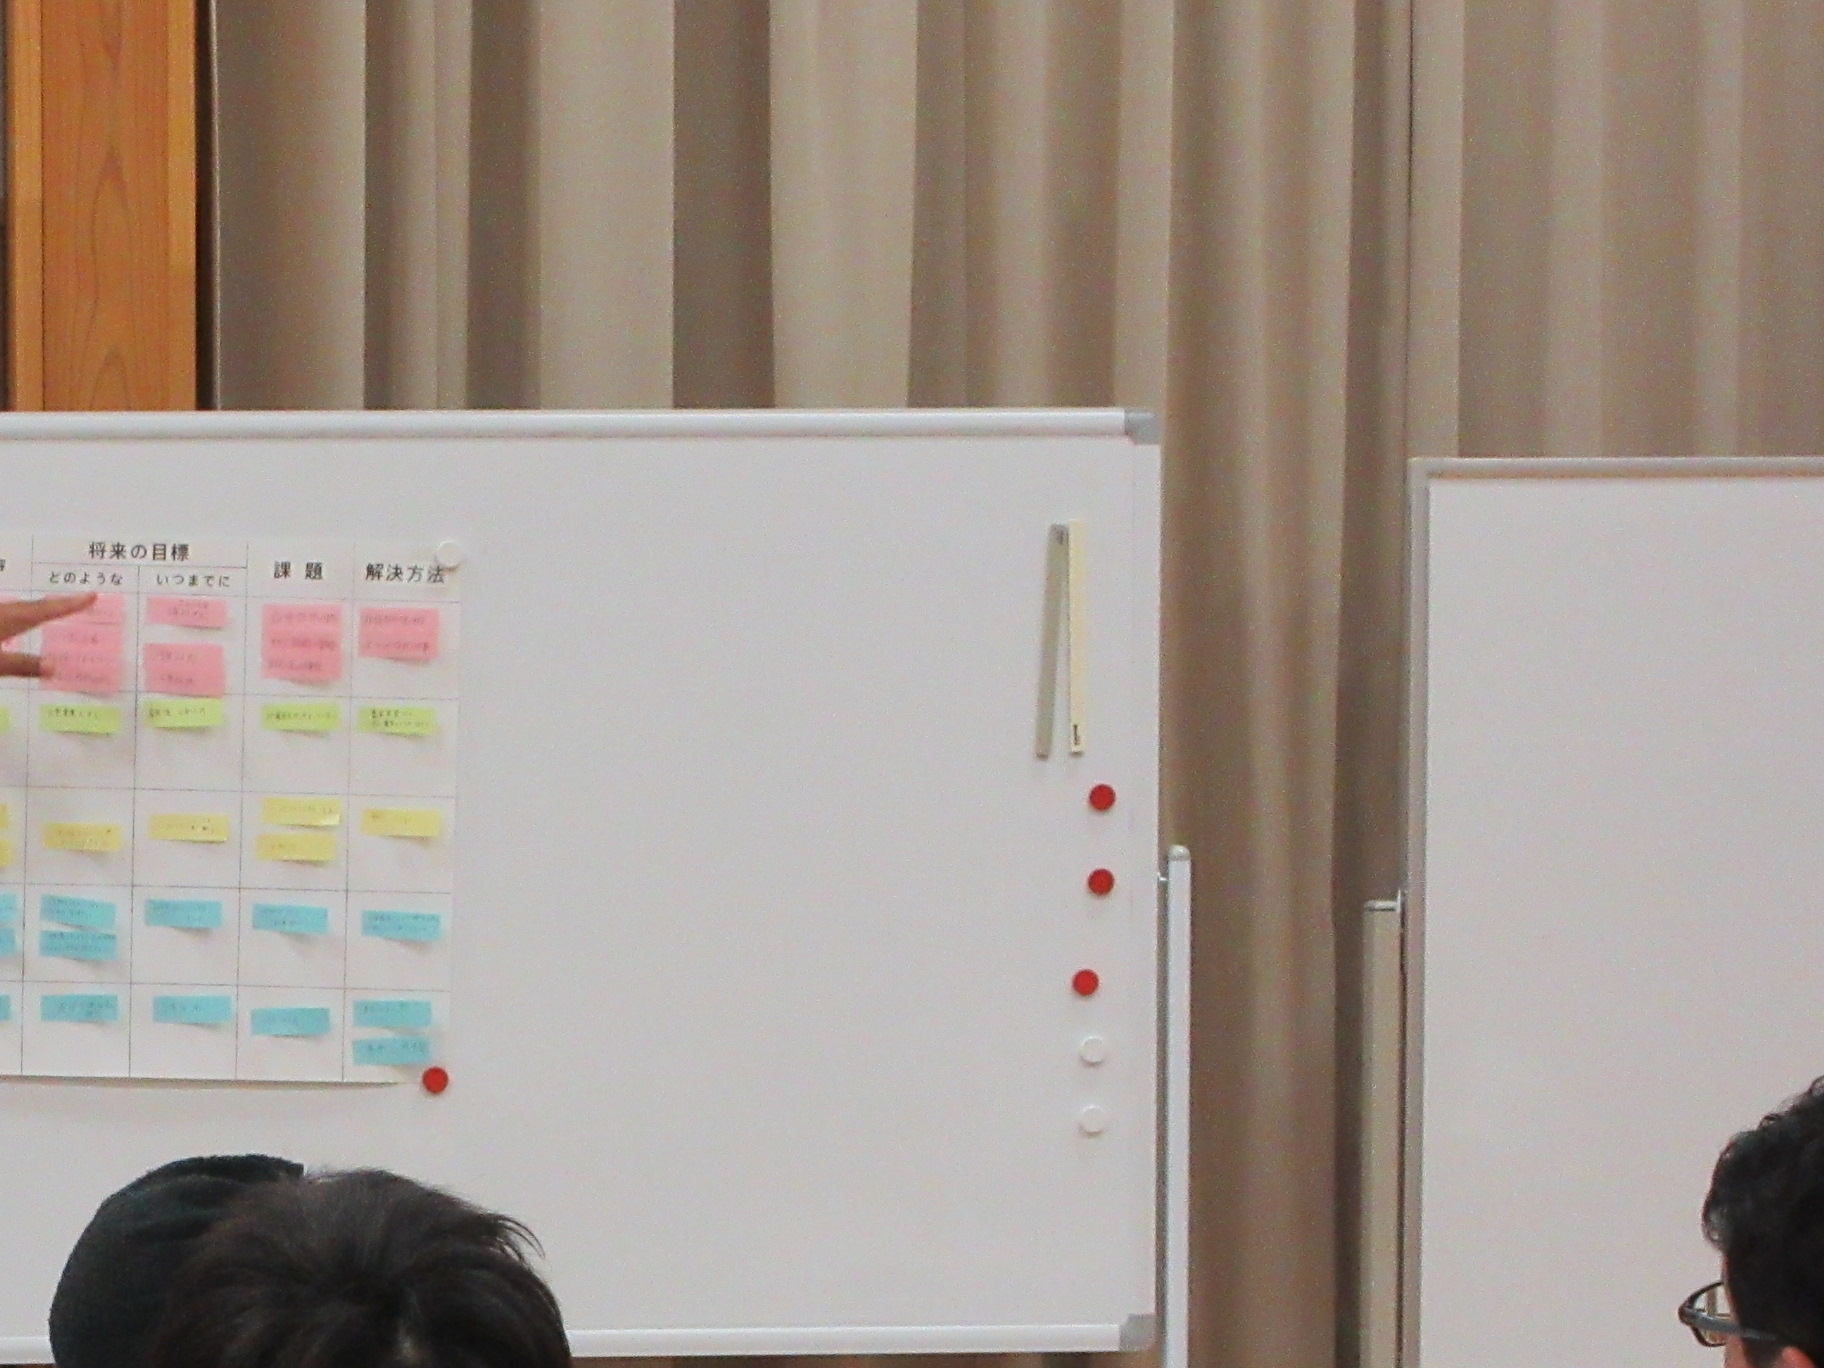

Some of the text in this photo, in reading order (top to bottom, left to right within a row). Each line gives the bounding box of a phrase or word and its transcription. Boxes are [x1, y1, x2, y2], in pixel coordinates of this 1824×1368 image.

[88, 541, 190, 561] 将来の目標
[156, 573, 231, 588] いつまでに
[365, 562, 446, 584] 解決方法
